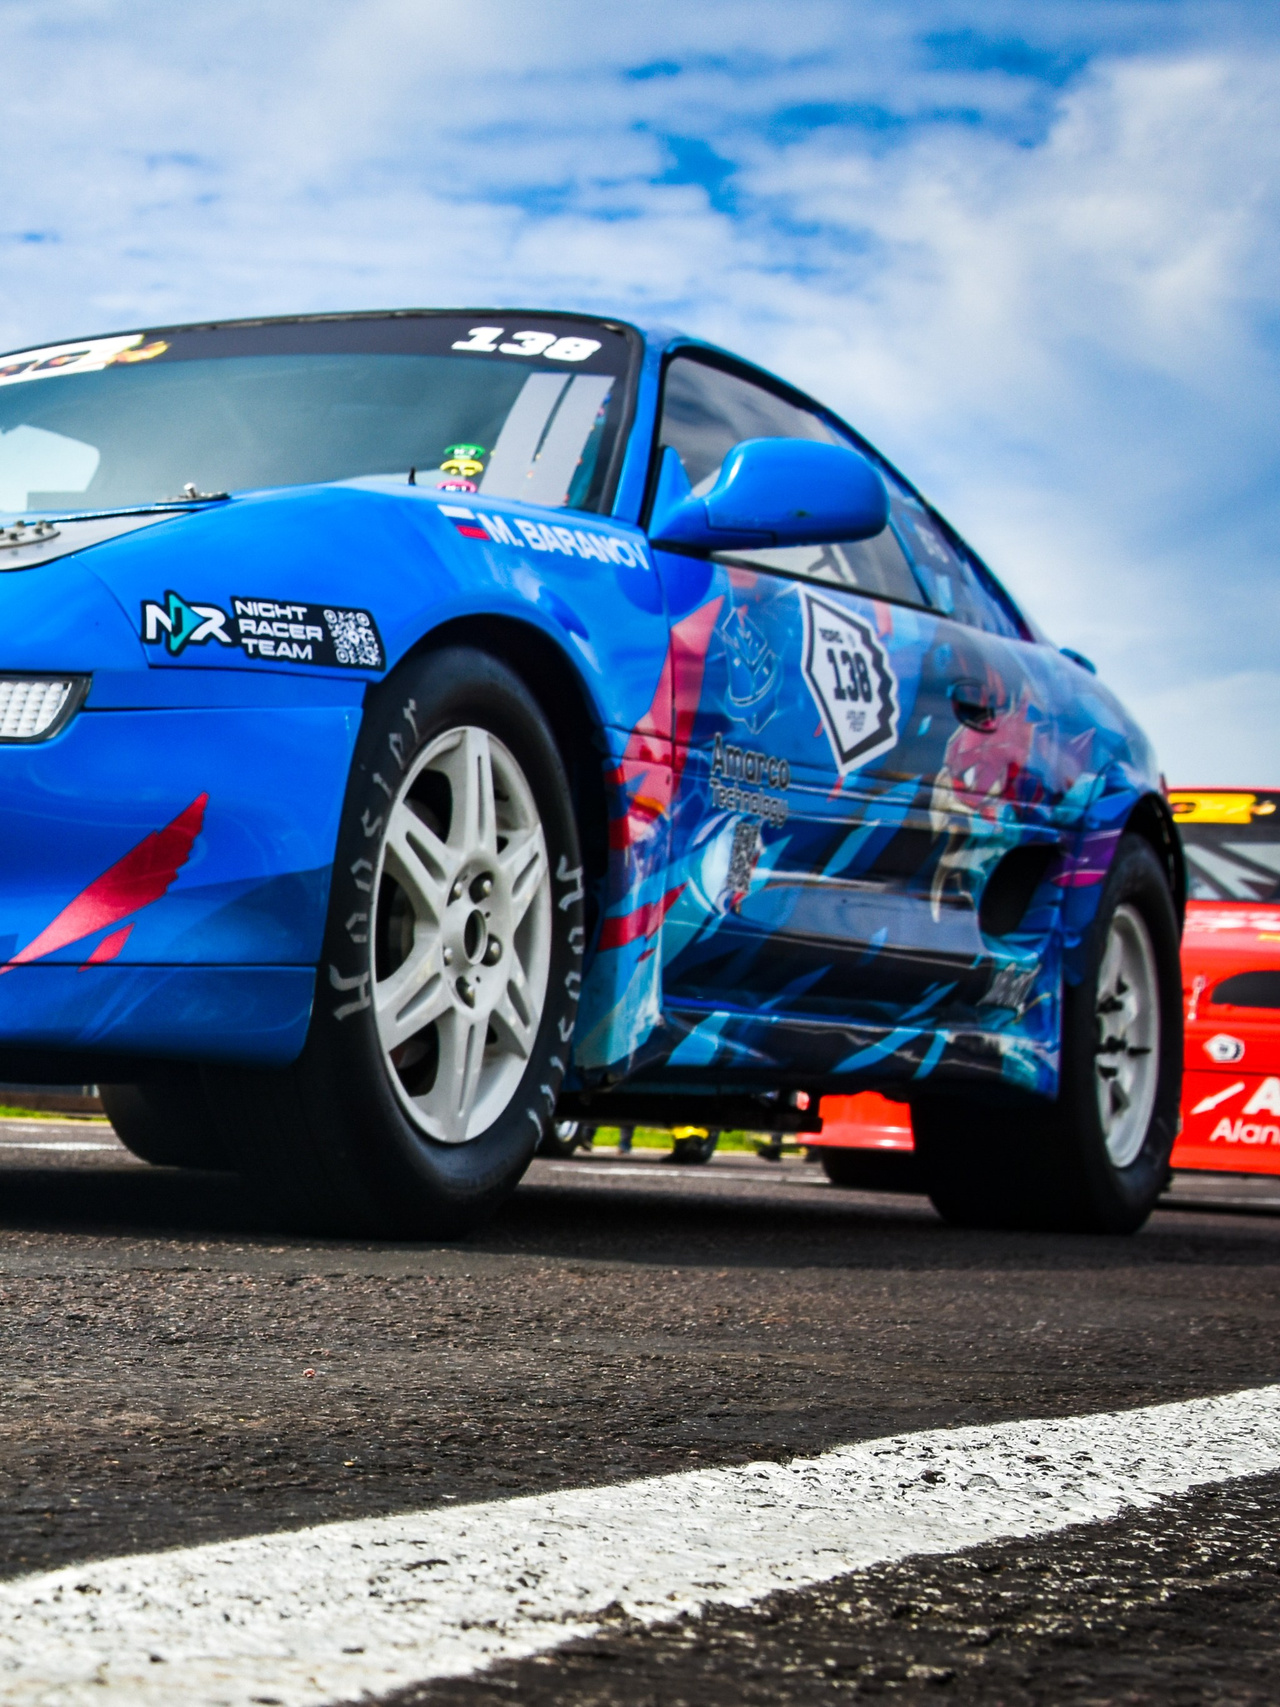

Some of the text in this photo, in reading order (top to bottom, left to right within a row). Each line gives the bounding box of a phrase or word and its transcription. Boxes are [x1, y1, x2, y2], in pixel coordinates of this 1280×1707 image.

[451, 326, 602, 362] 138
[477, 513, 650, 570] M. BARANOV
[234, 600, 307, 621] NIGHT
[238, 618, 323, 641] RACER
[241, 638, 312, 660] TEAM
[827, 648, 873, 704] 138
[710, 732, 790, 791] Amarco
